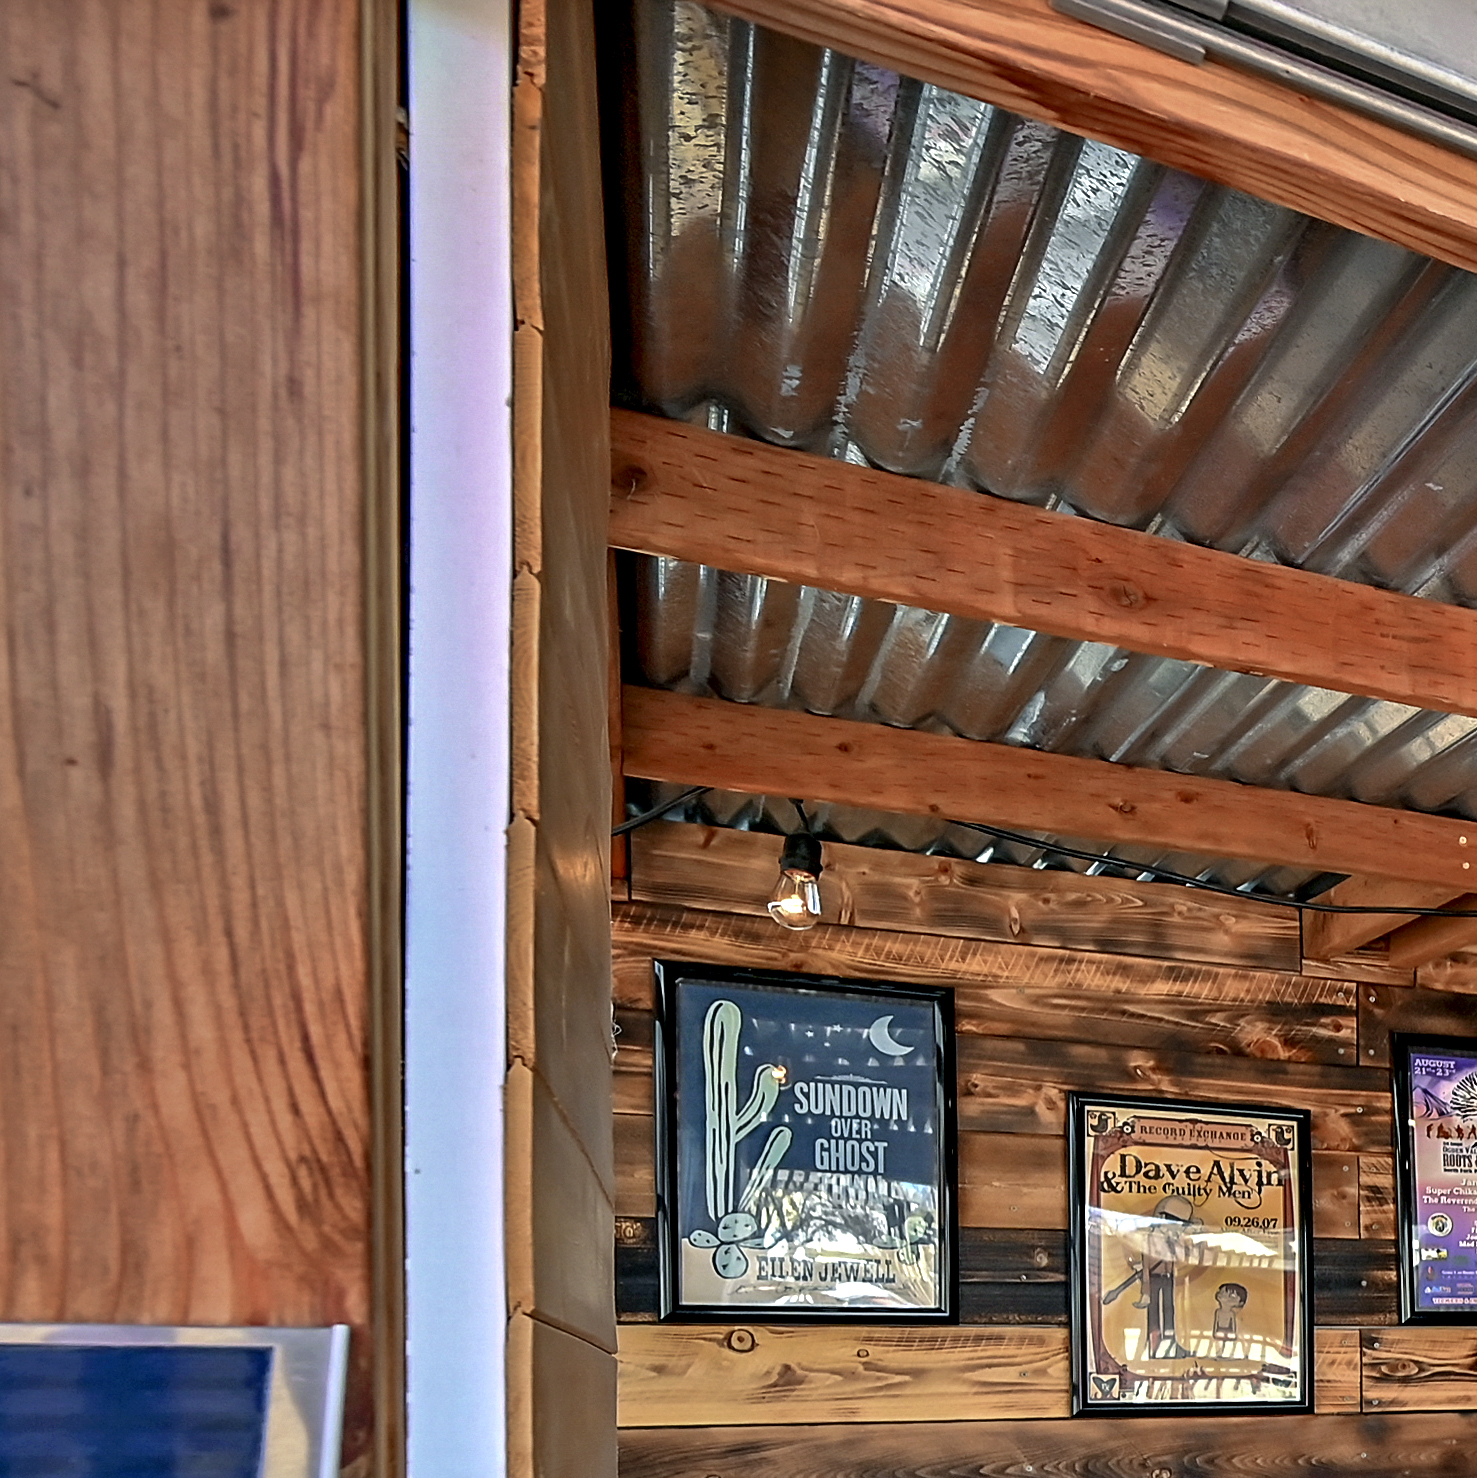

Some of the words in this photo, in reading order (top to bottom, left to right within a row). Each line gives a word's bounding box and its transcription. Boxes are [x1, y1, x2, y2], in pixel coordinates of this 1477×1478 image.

[1414, 1058, 1456, 1069] AUGUST
[794, 1081, 908, 1121] SUNDOWN
[831, 1118, 871, 1139] OVER
[1140, 1125, 1186, 1137] RECORD
[1189, 1127, 1246, 1141] EXCHANGE
[815, 1140, 888, 1174] GHOST
[1443, 1154, 1473, 1168] ROOTS
[1118, 1153, 1201, 1181] Dave
[1206, 1160, 1284, 1189] Alvin
[1100, 1170, 1124, 1193] &
[1125, 1180, 1157, 1194] The
[1162, 1182, 1212, 1199] Guilty
[1217, 1184, 1252, 1200] Men
[1426, 1186, 1451, 1197] Super
[1423, 1195, 1440, 1204] The
[1225, 1216, 1278, 1229] 09.26.07
[756, 1255, 814, 1281] EILEN
[818, 1259, 896, 1283] JEWELL
